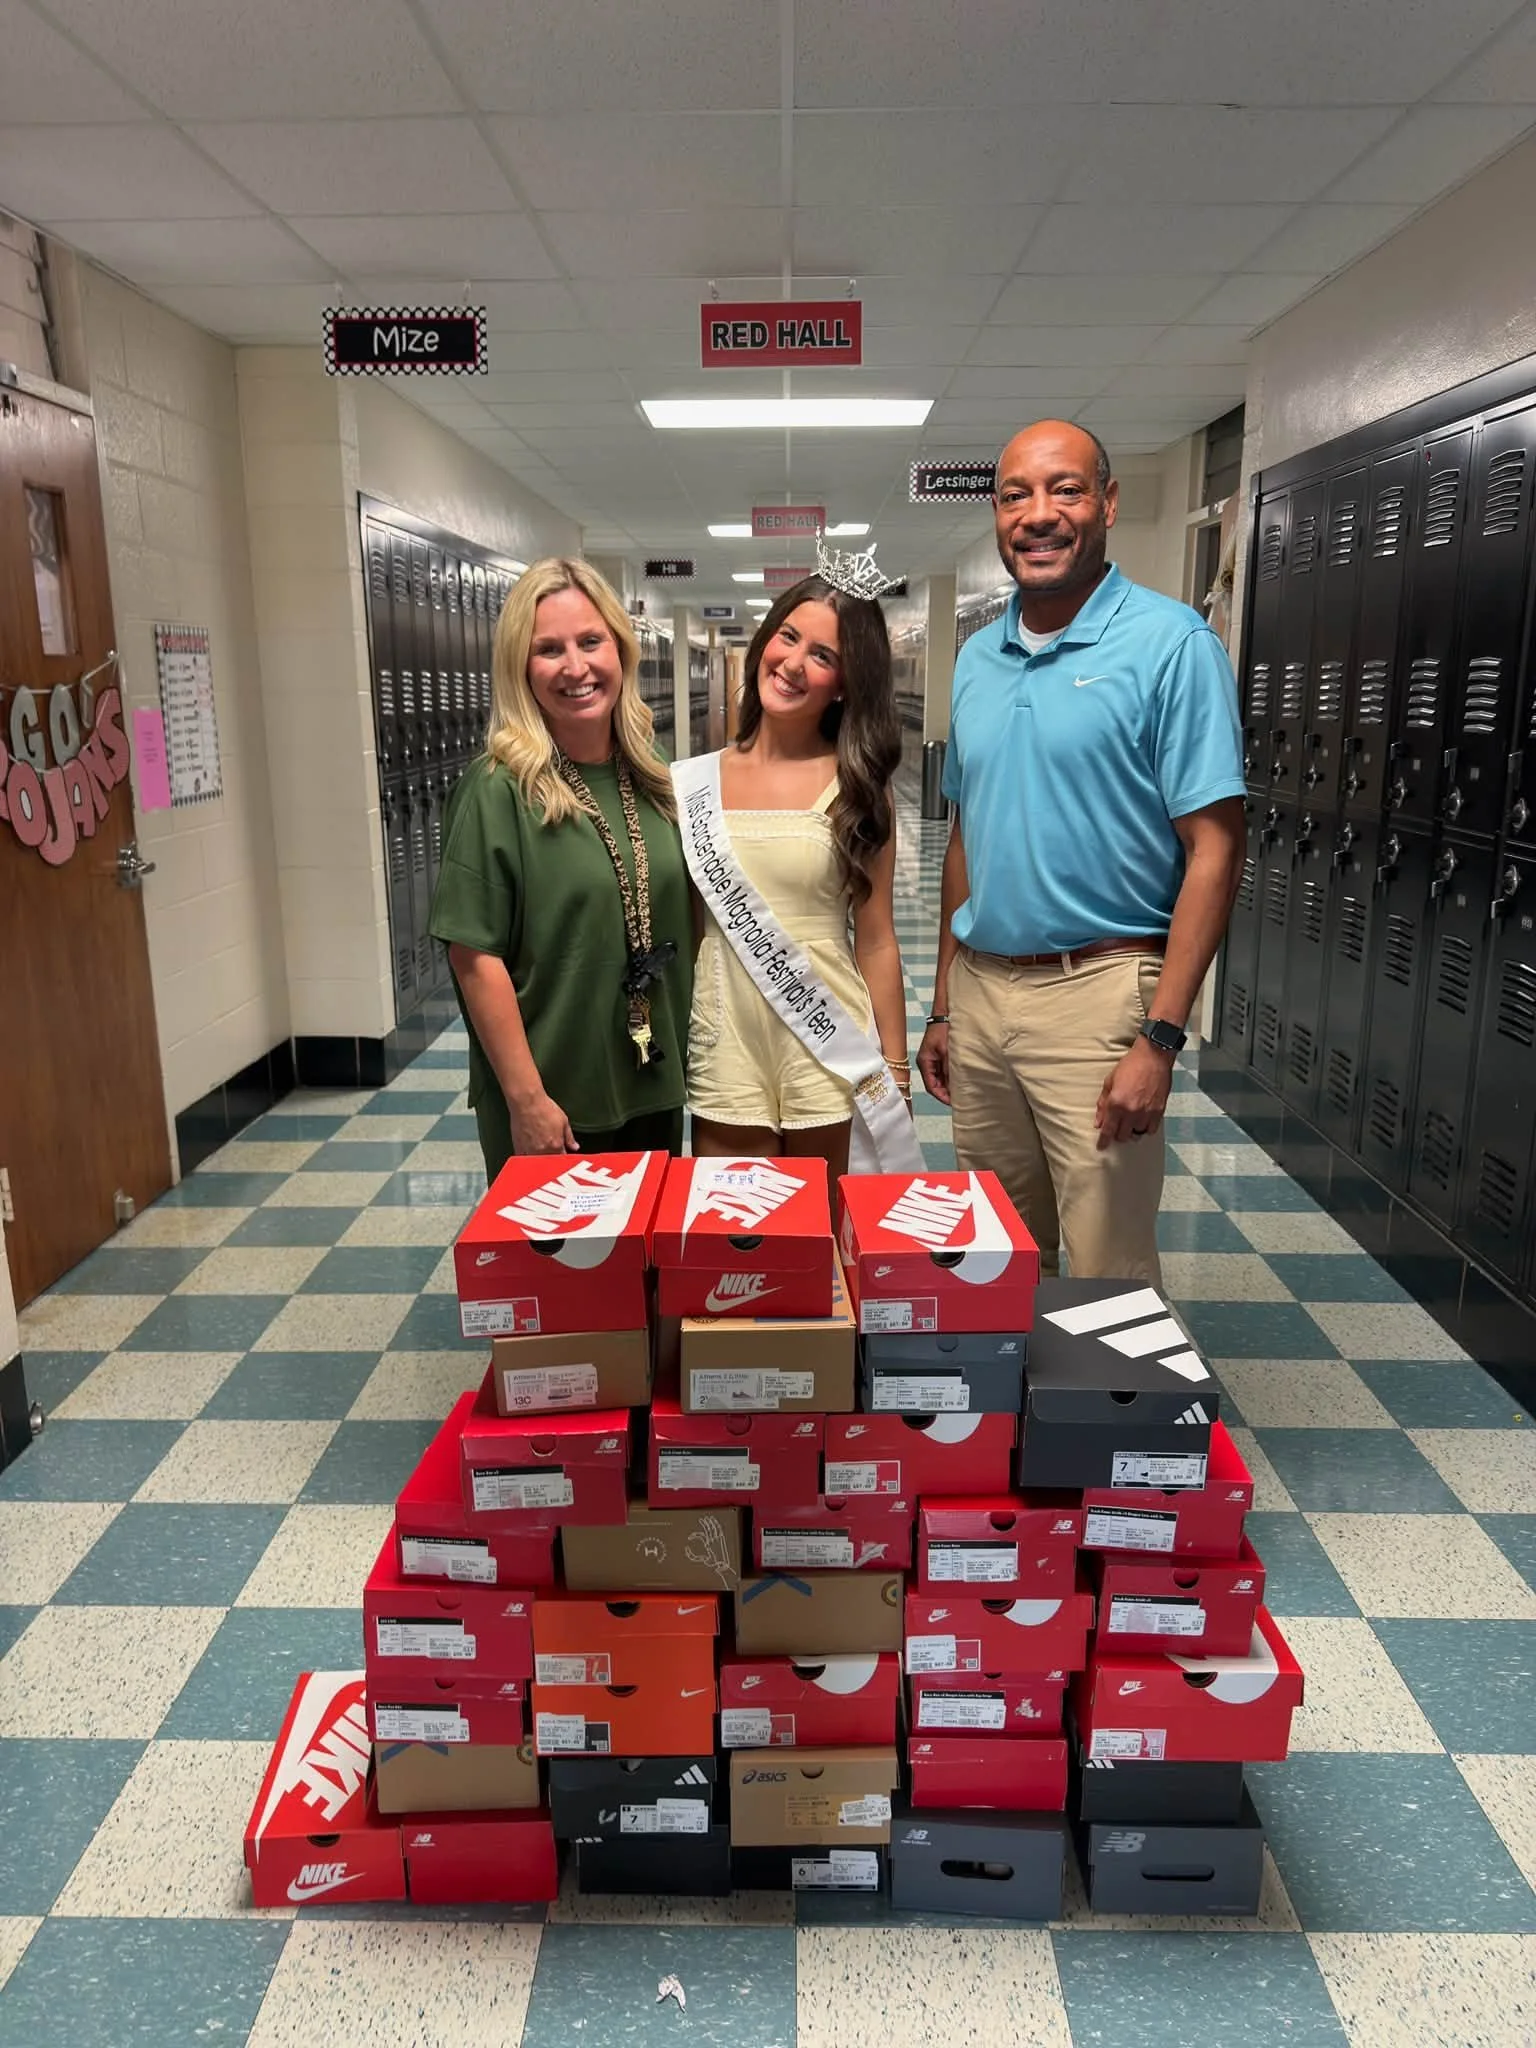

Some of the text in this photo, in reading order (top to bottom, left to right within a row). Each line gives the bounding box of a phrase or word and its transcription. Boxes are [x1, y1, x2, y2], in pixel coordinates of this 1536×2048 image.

[373, 325, 440, 357] Mize
[711, 320, 852, 349] RED HALL
[924, 473, 992, 490] Letsinger
[757, 515, 821, 528] RED HALL
[684, 785, 837, 1044] Miss Gardendale Magnolia Festival's Teen
[495, 1160, 622, 1232] NIKE
[877, 1178, 975, 1245] NIKE
[716, 1273, 767, 1295] NIKE
[1119, 1461, 1129, 1472] 7
[757, 1771, 788, 1783] asics
[630, 1814, 638, 1824] 7
[905, 1828, 929, 1841] NB
[1097, 1832, 1147, 1853] NB
[296, 1862, 348, 1885] NIKE
[798, 1867, 806, 1877] 6
